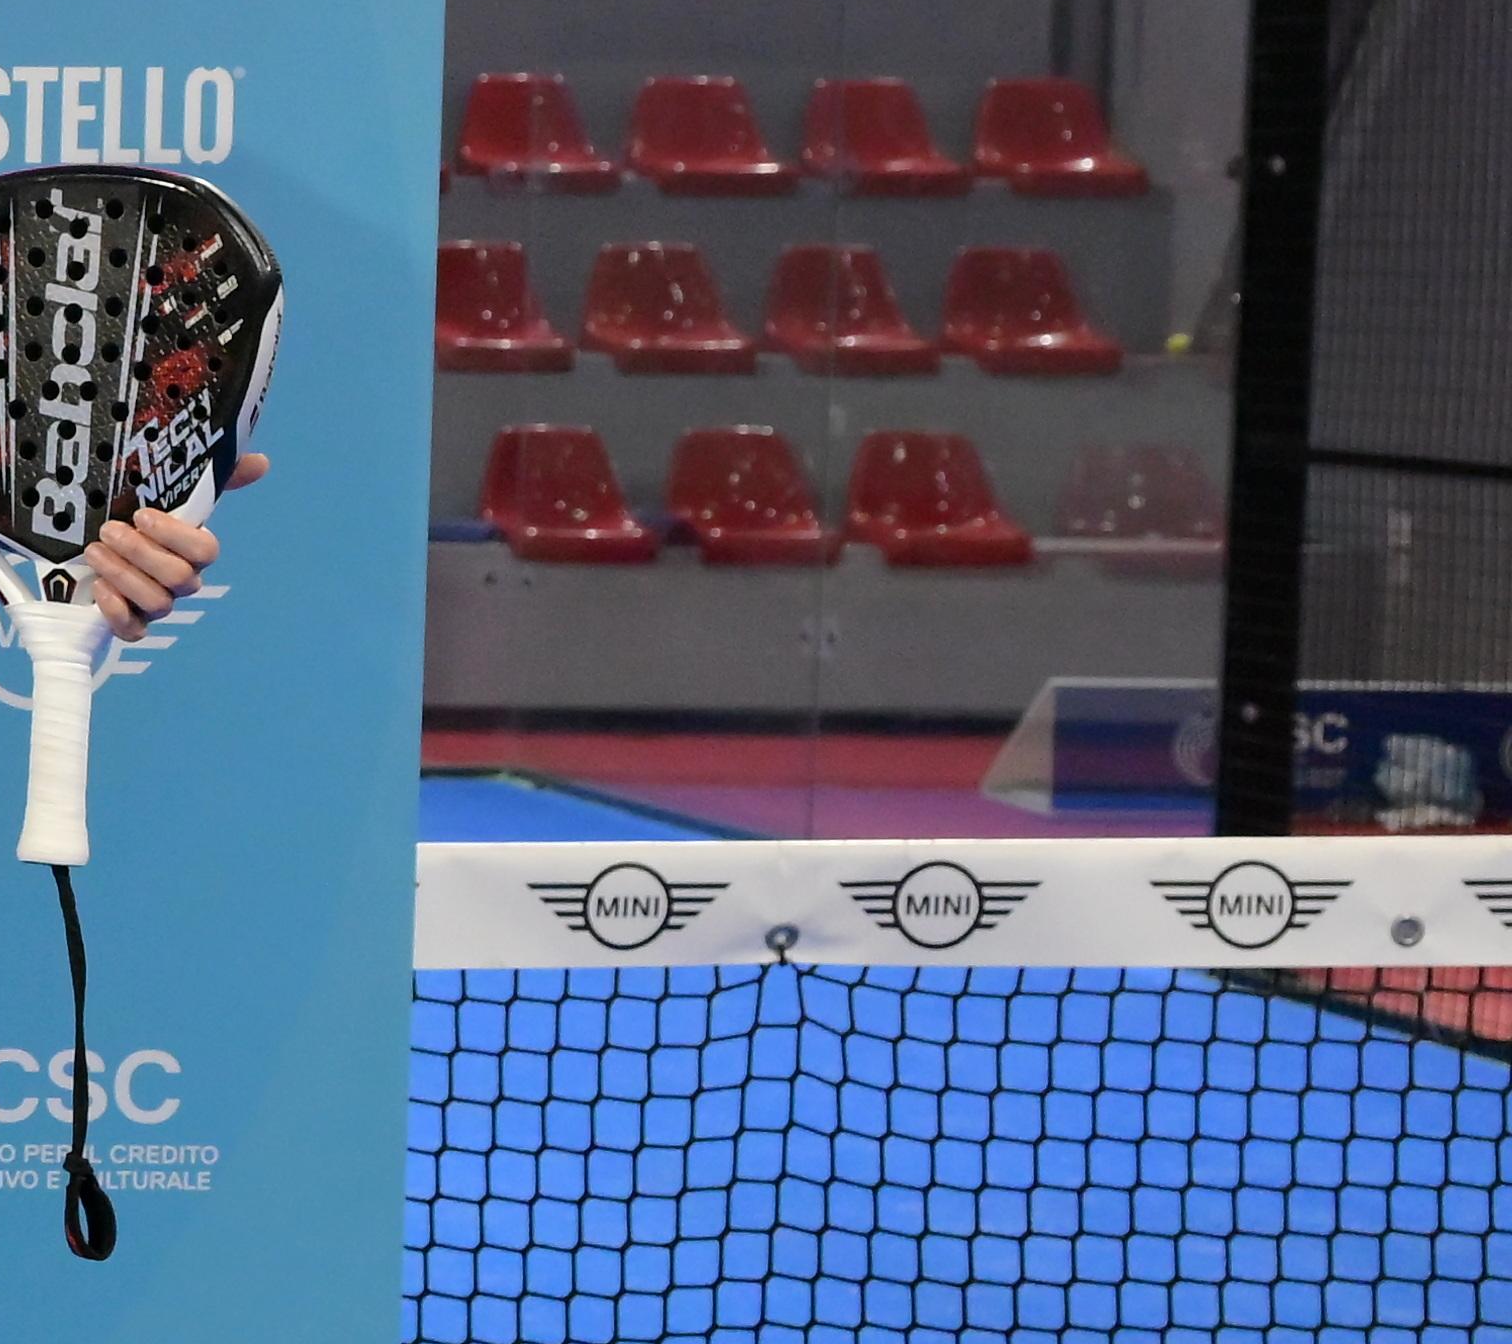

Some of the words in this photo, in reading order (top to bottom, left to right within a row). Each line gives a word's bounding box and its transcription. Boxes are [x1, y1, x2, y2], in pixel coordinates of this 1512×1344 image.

[595, 897, 660, 918] MINI
[905, 895, 971, 917] MINI
[1218, 894, 1285, 916] MINI
[110, 1145, 219, 1165] CREDITO
[47, 1170, 61, 1189] E
